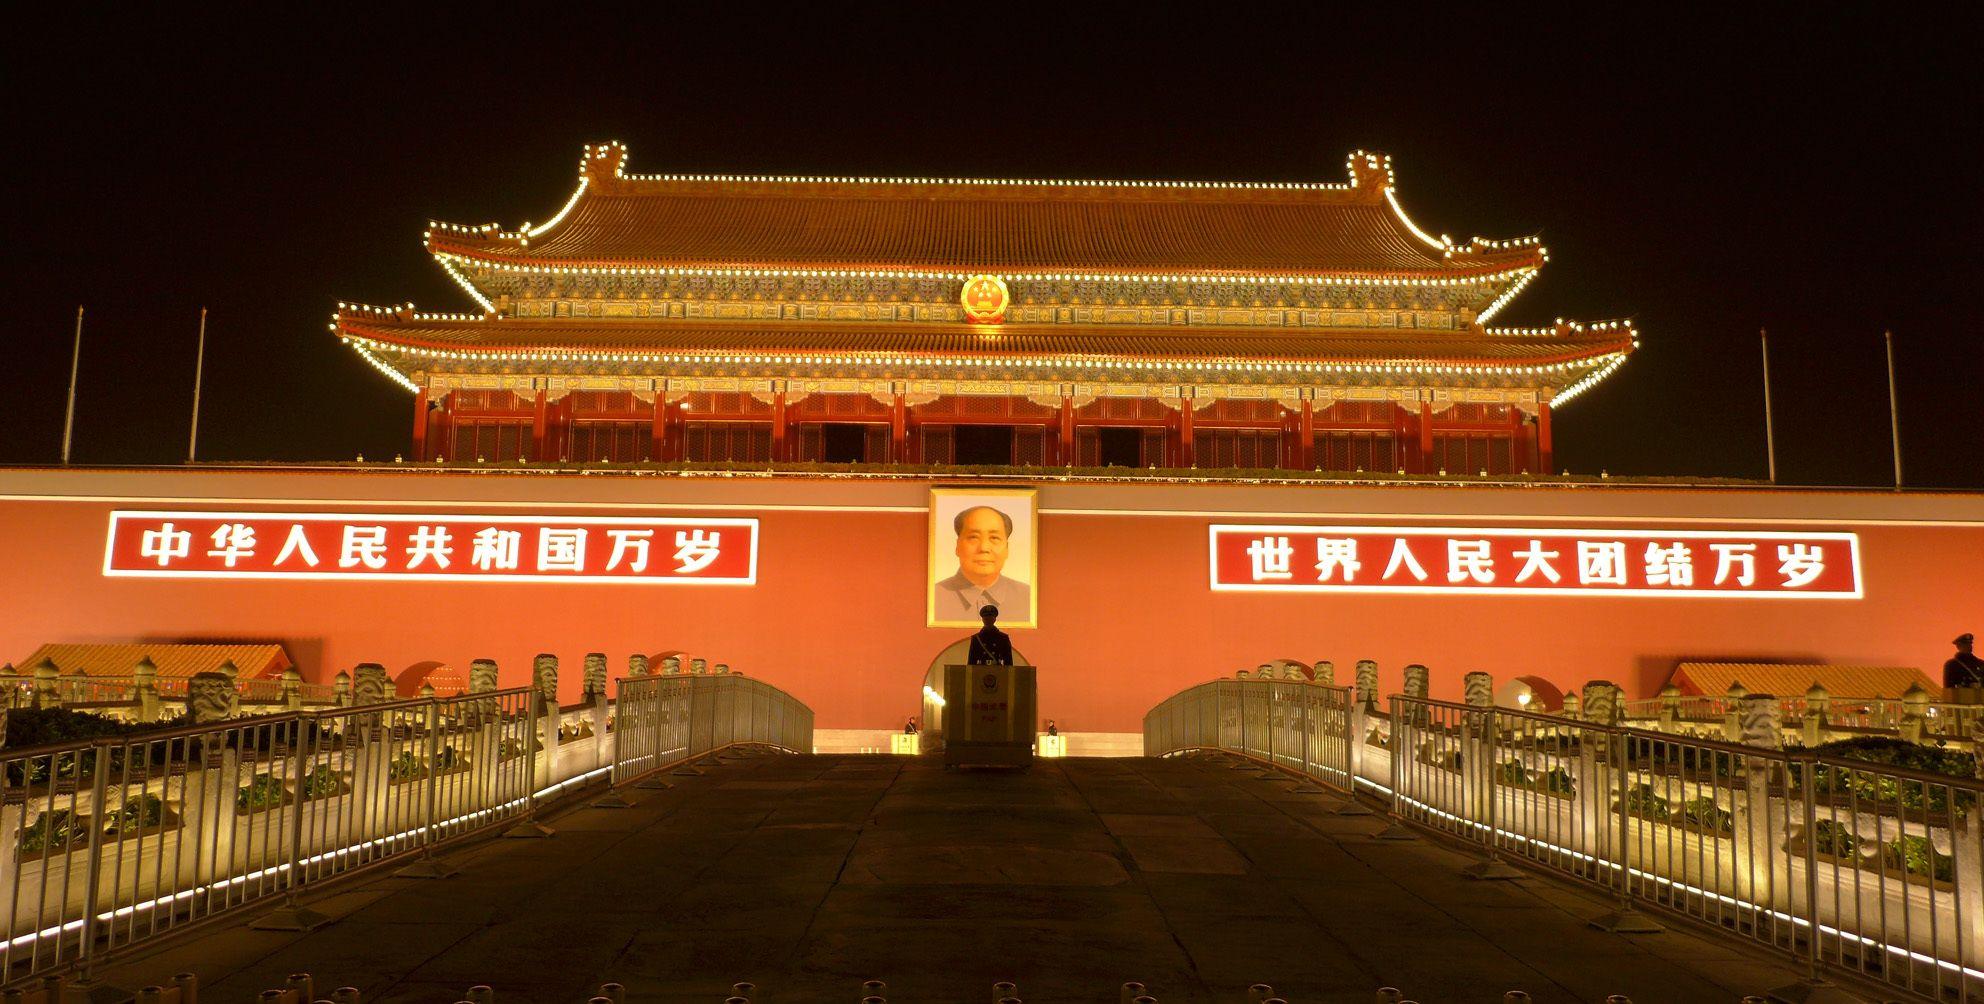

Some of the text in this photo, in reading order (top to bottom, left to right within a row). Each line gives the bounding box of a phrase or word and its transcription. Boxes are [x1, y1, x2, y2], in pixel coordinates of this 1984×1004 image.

[141, 522, 721, 573] 中华人民共和国万岁
[1246, 536, 1827, 588] 世界人民大团结万岁
